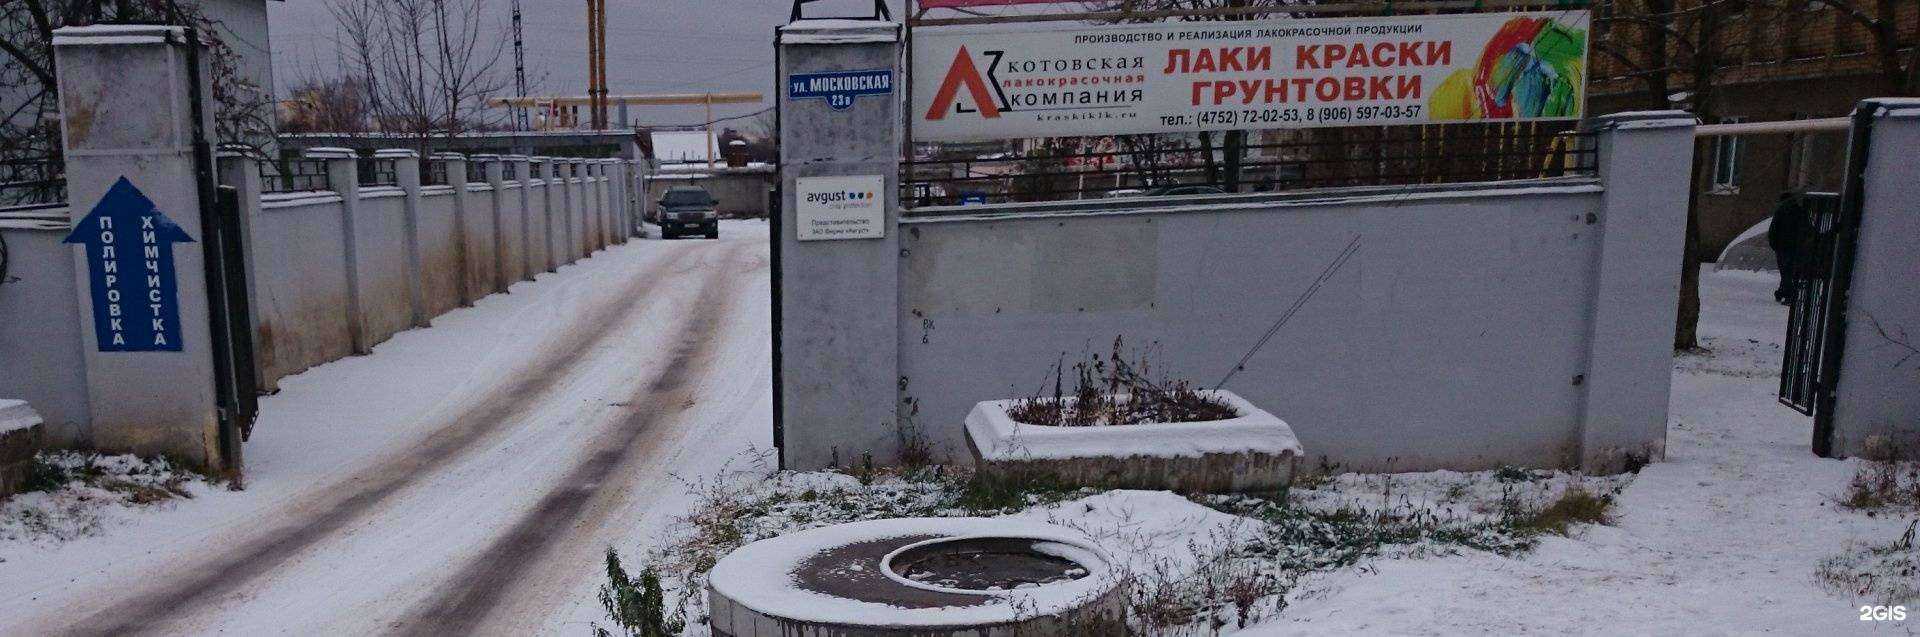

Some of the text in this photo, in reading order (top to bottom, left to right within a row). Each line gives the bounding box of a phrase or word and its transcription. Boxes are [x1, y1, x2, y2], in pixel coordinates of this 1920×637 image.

[1074, 24, 1422, 44] ПРОИЗВОДСТВО И РЕАЛИЗАЦИЯ ЛАКОКРАСОЧНОЙ ПРОДУКЦИИ
[1163, 40, 1452, 75] ЛАКИ КРАСКИ
[810, 74, 889, 92] МОСКОВСКАЯ
[1191, 75, 1422, 106] ГРУНТОВКИ
[1160, 105, 1422, 127] тел.: (4752) 72-02-53, 8 (906) 597-03-57
[807, 190, 846, 204] avgust
[100, 216, 125, 345] ПОЛИРОВКА
[141, 216, 167, 345] ХИМЧИСТКА
